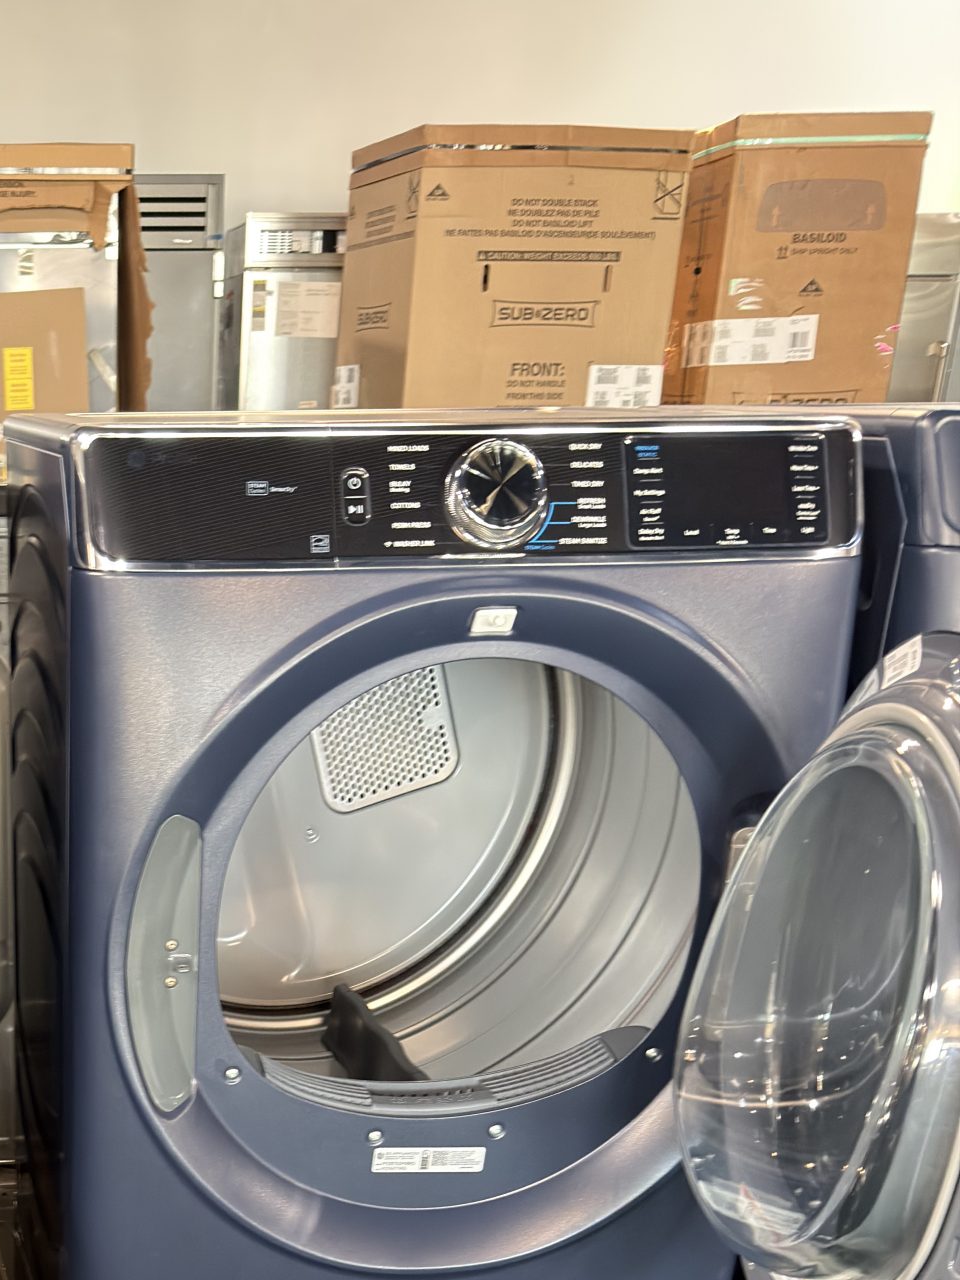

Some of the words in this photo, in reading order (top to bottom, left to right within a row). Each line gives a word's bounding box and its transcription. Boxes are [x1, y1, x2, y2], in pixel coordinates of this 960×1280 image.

[541, 199, 572, 207] DOUBLE
[574, 199, 598, 207] STACK
[512, 219, 524, 227] DO
[526, 219, 541, 227] NOT
[542, 220, 577, 228] BASILOID
[792, 232, 847, 244] BASILOID
[523, 252, 552, 260] WEIGHT
[511, 362, 565, 376] FRONT:
[581, 537, 608, 545] SANITIZE
